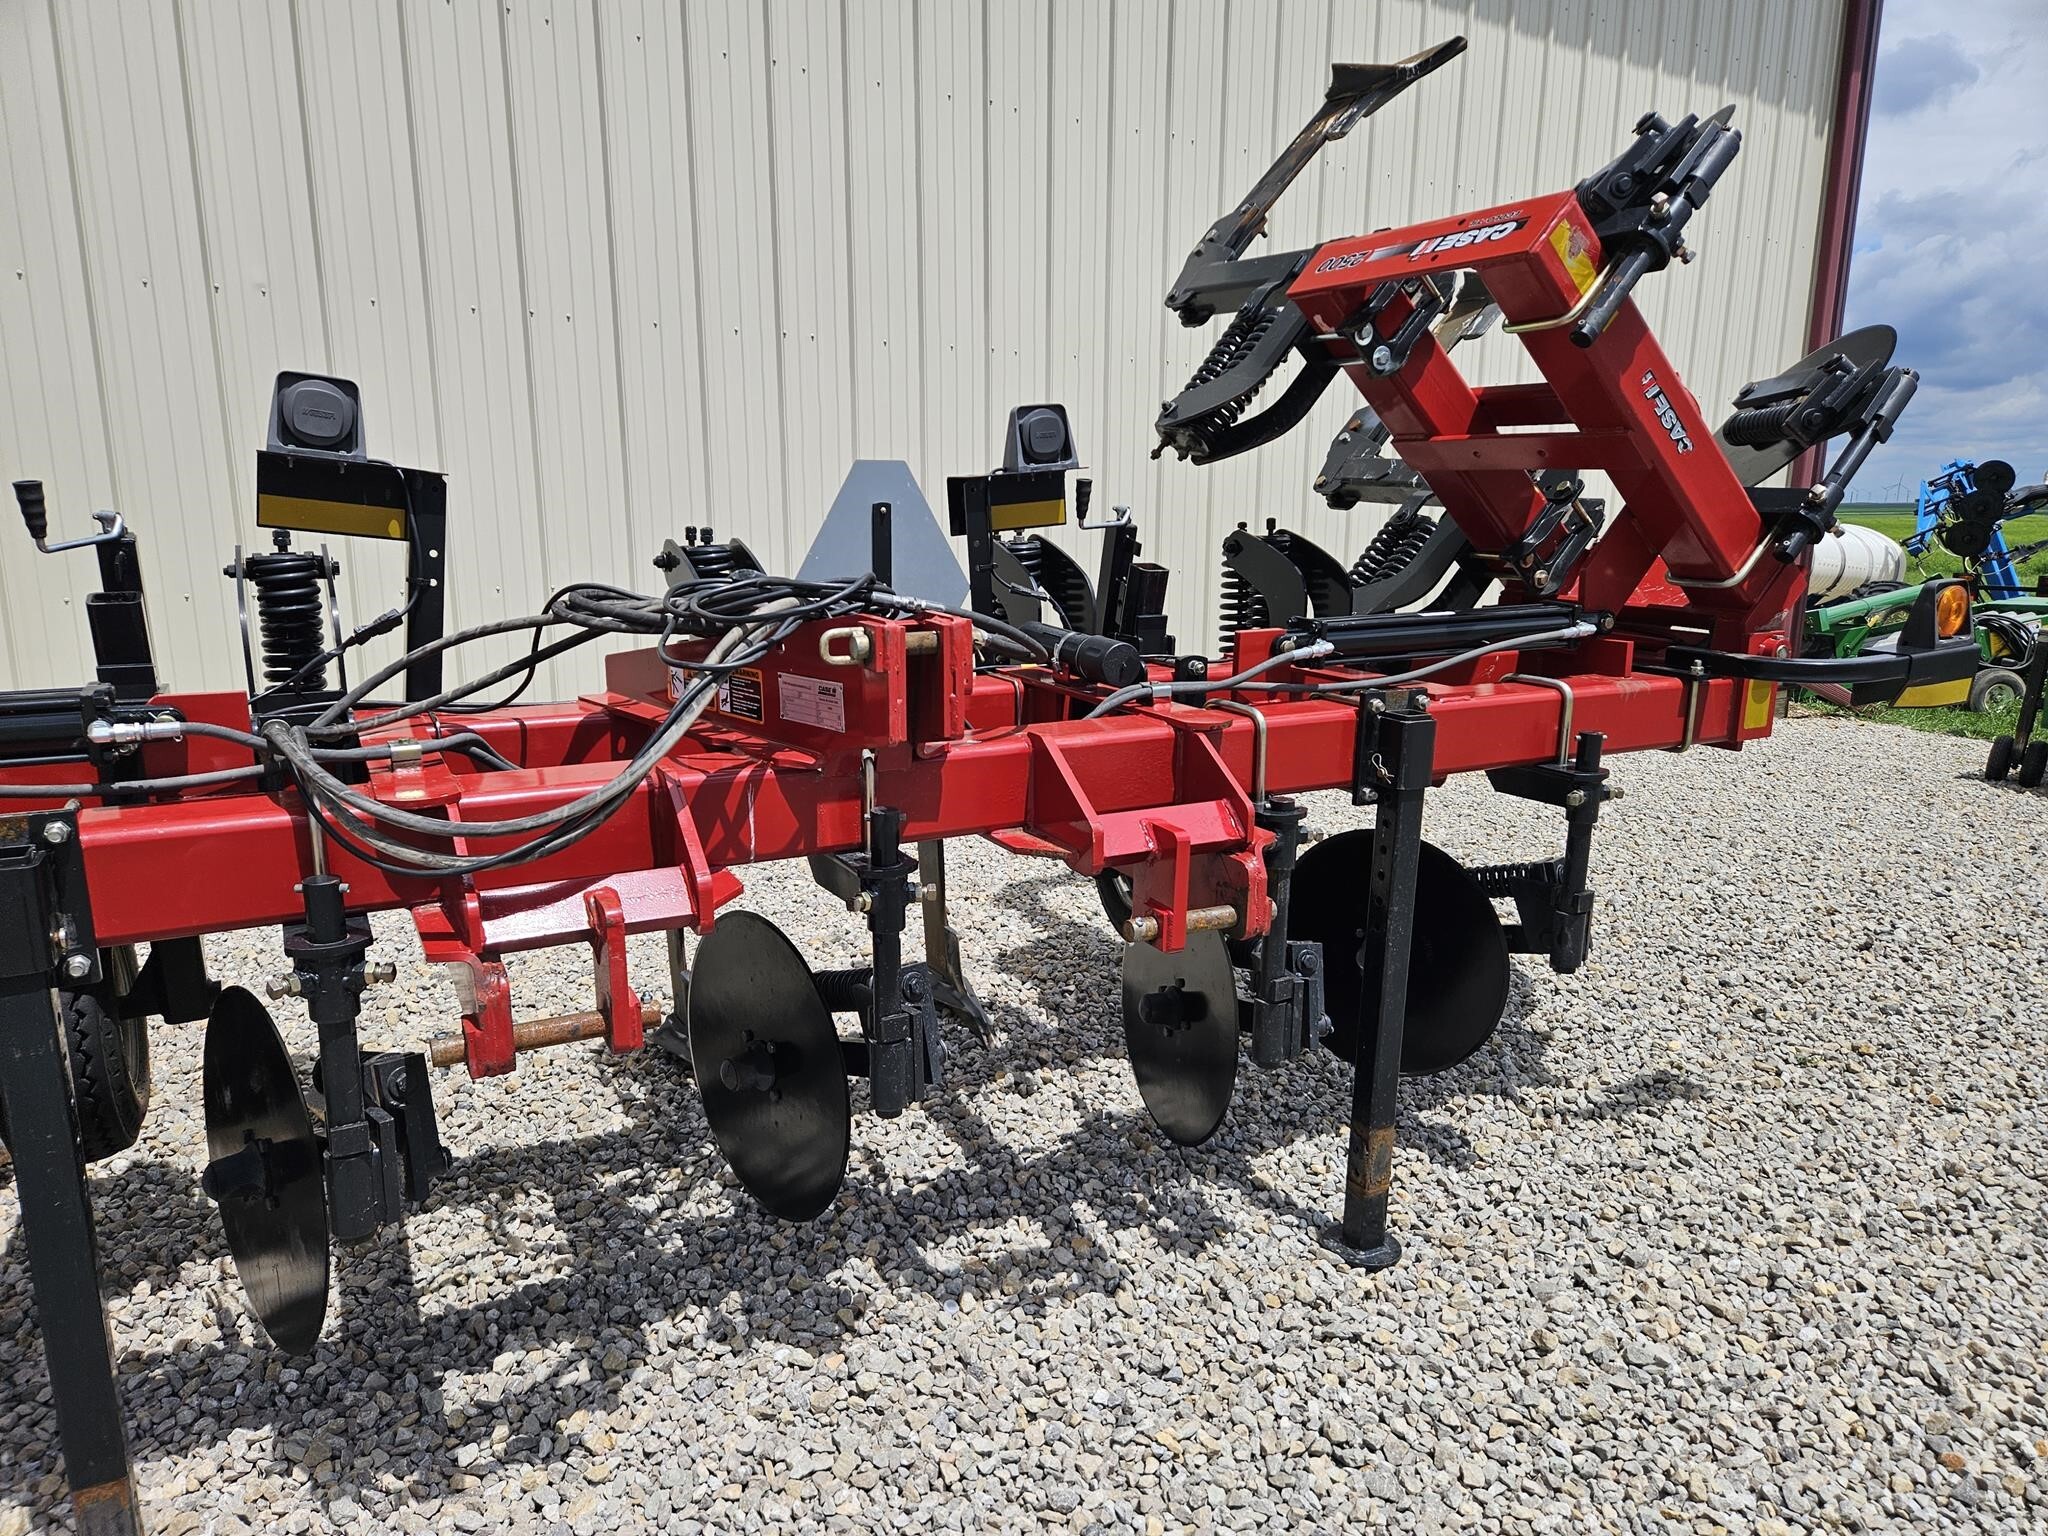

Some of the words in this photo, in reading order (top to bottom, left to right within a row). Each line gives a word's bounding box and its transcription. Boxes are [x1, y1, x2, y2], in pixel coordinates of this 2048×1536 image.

[1434, 221, 1518, 252] CASE
[1315, 250, 1369, 274] 2500
[1653, 391, 1694, 454] CASE
